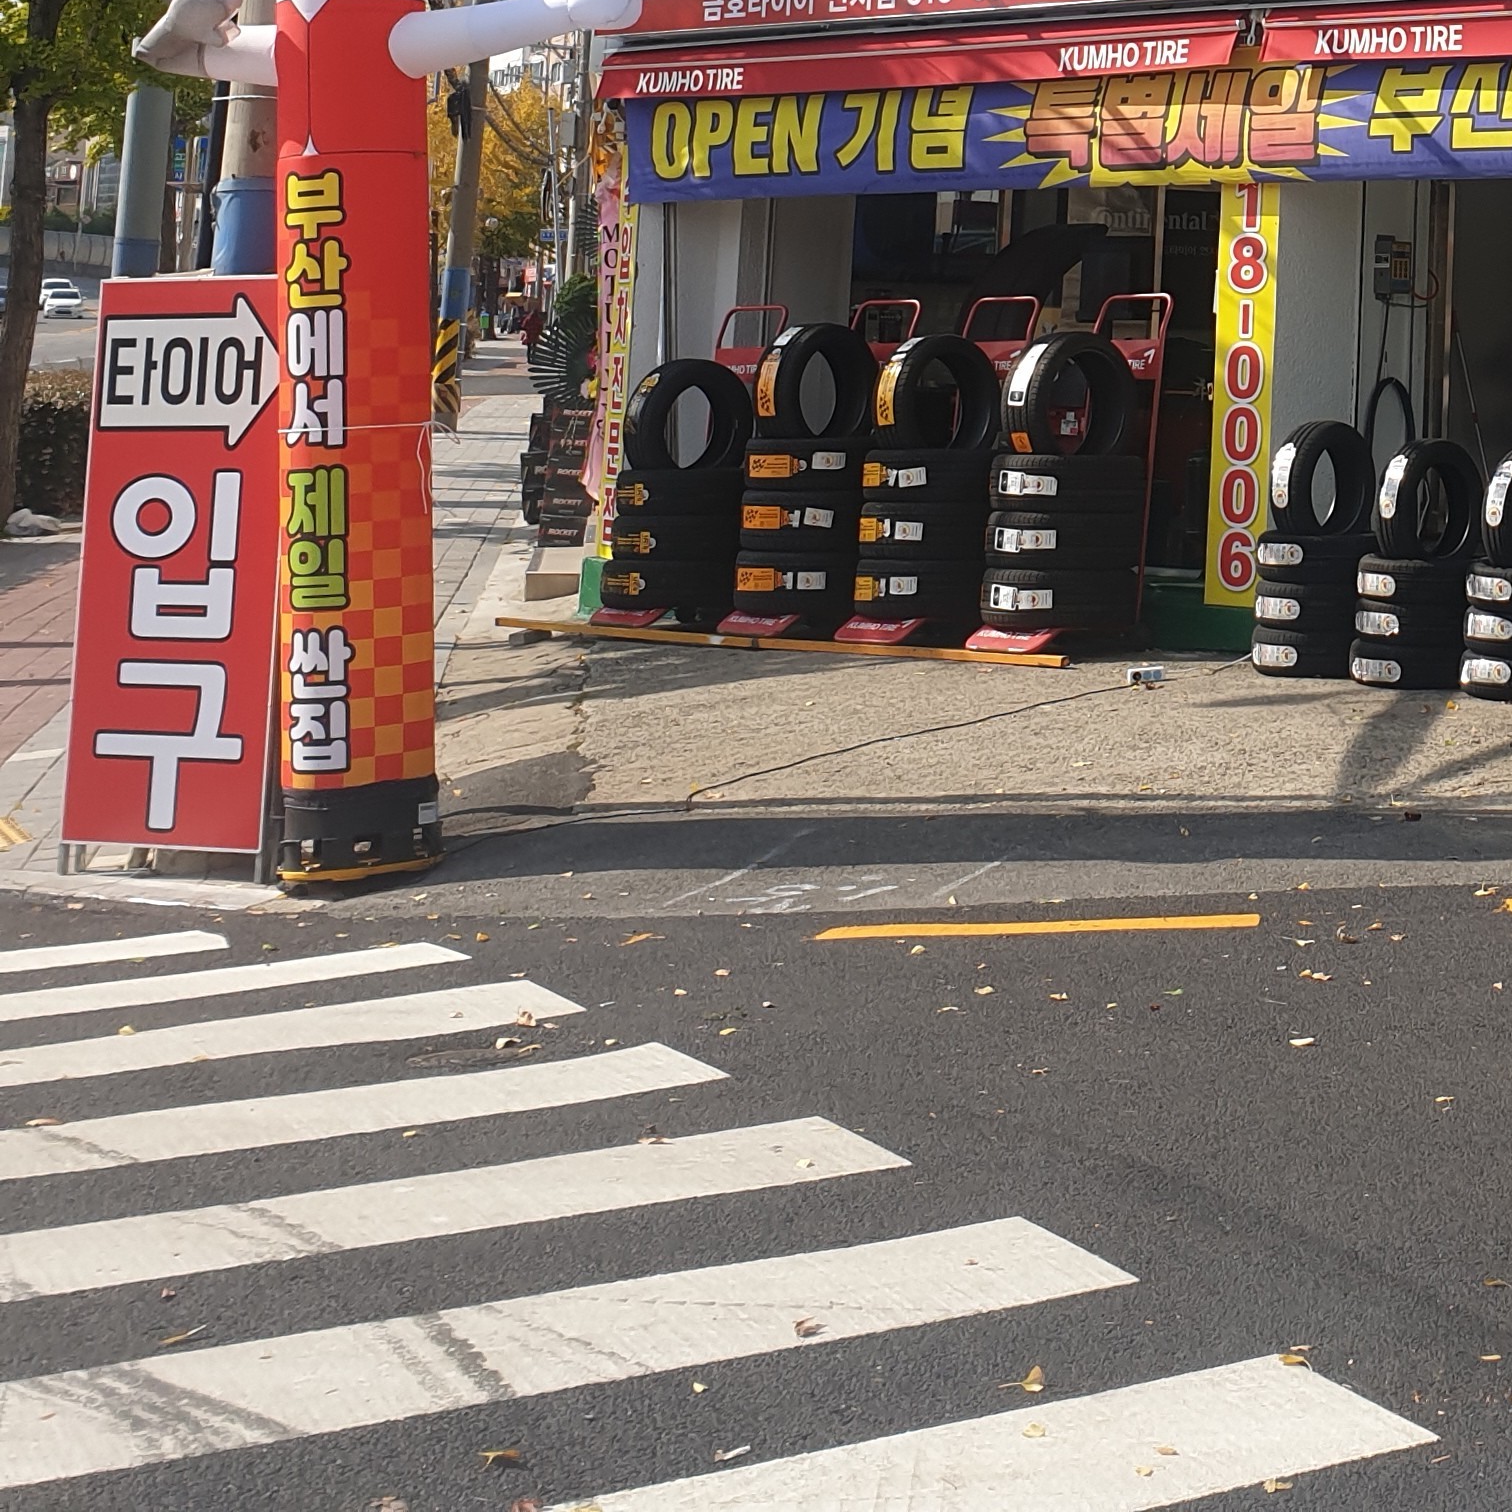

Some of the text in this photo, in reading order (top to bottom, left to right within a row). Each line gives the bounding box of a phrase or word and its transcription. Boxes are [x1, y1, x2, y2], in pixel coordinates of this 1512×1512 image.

[1058, 39, 1189, 71] KUMHO TIRE
[1314, 24, 1463, 54] KUMHO TIRE
[636, 66, 744, 93] KUMHO TIRE
[650, 92, 827, 181] OPEN
[834, 85, 976, 175] 기념
[1023, 68, 1328, 173] 특별세일
[107, 335, 265, 407] 타이어
[285, 167, 355, 774] 부산에서 제일 싼집
[93, 468, 243, 832] 입구
